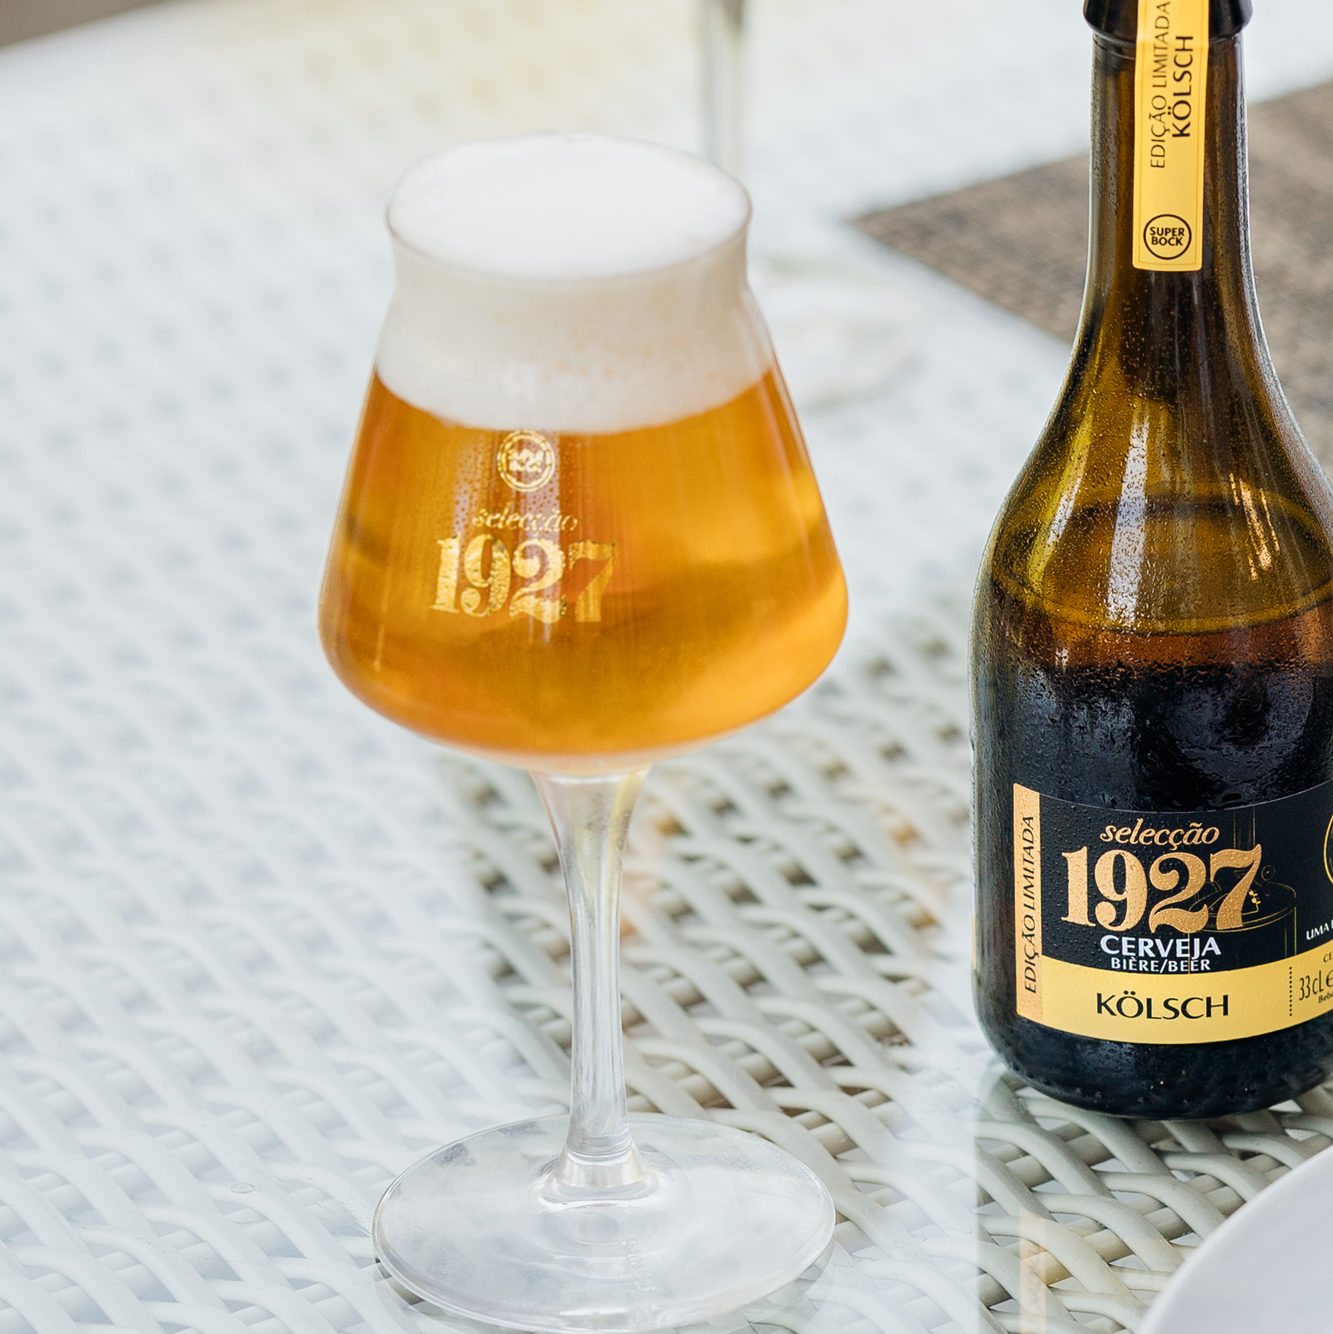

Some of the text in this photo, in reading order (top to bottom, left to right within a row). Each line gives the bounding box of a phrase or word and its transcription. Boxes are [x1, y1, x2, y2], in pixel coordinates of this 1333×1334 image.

[1148, 0, 1171, 169] EDIÇÃO LIMITADA
[1166, 35, 1194, 139] KÖLSCH
[1149, 225, 1185, 237] SUPER
[1150, 236, 1183, 247] BOCK
[430, 533, 618, 624] 1927
[1100, 818, 1220, 851] selecção
[1061, 843, 1263, 934] 1927
[1021, 816, 1040, 994] EDIÇÃO LIMITADA
[1100, 934, 1222, 960] CERVEJA
[1306, 923, 1330, 941] UMA
[1110, 956, 1212, 974] BIÈRE/BEER
[1096, 990, 1229, 1020] KÖLSCH
